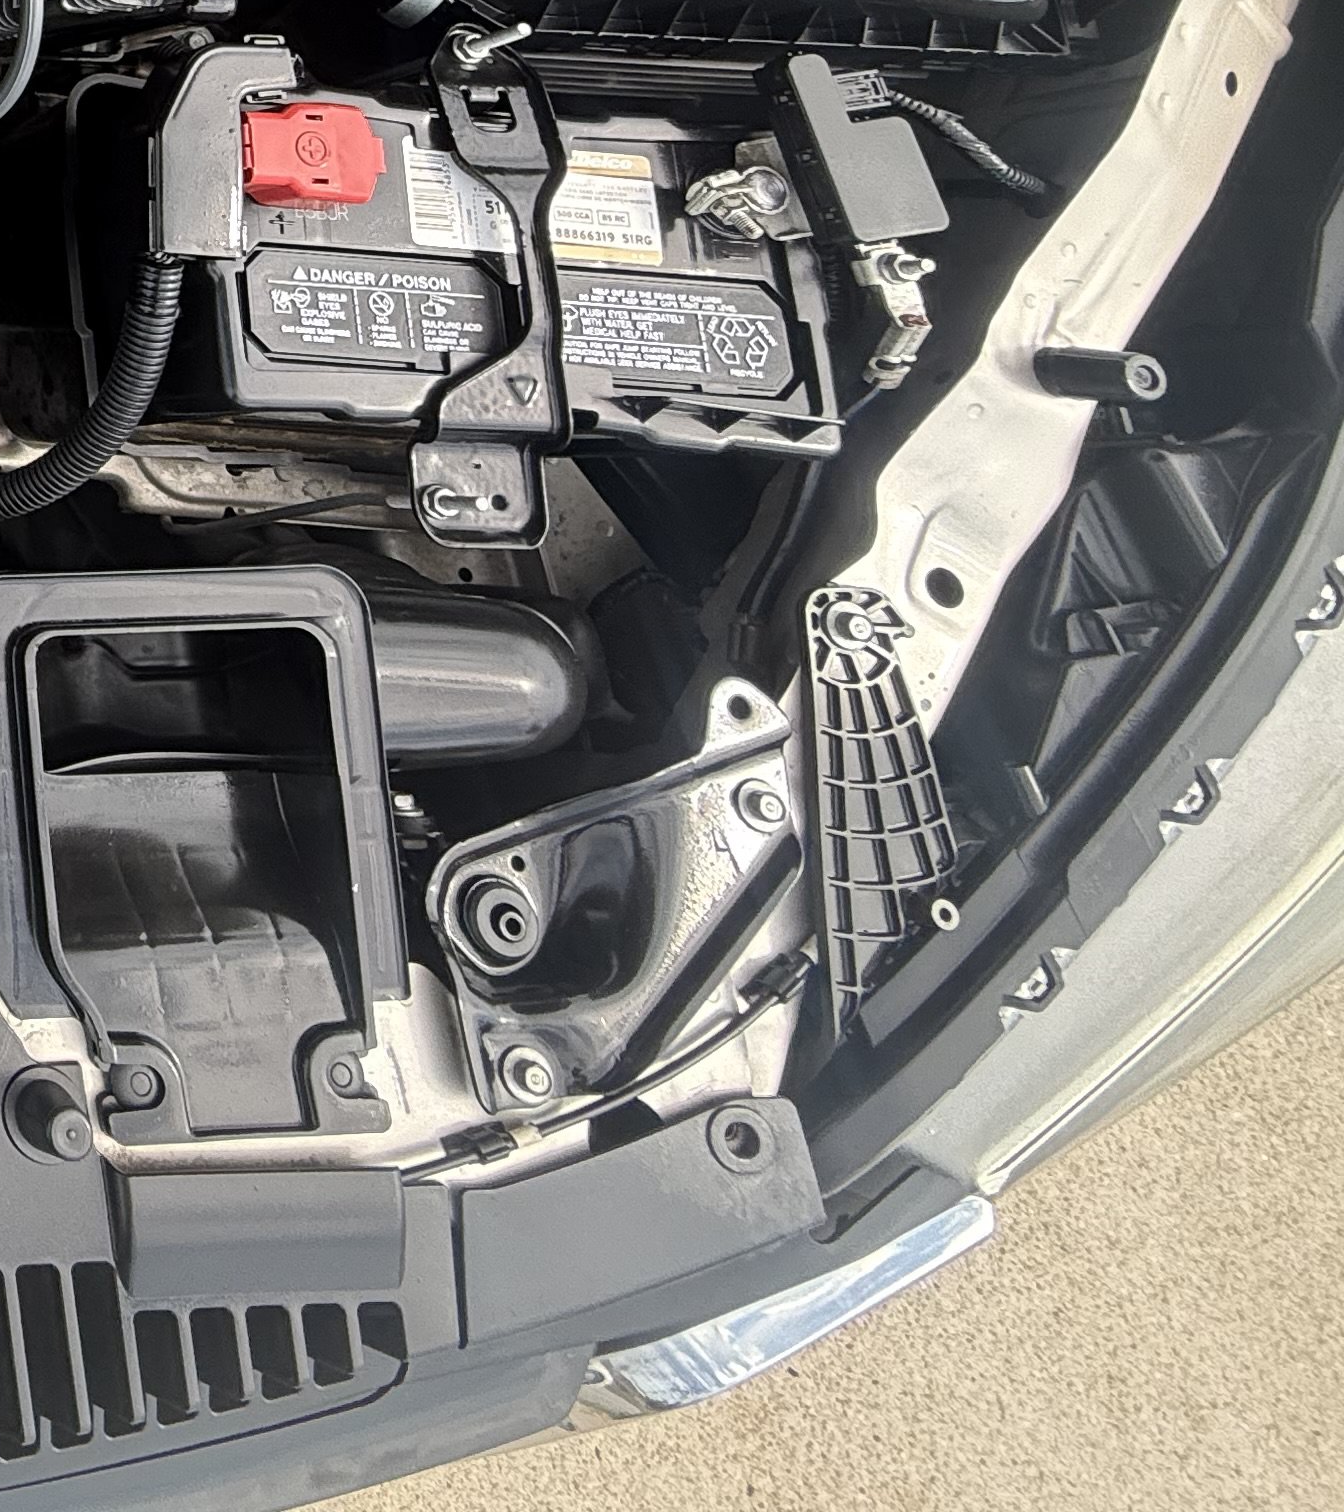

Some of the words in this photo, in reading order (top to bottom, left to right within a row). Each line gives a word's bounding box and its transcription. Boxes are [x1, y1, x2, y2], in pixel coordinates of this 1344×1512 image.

[574, 211, 590, 220] CCA
[614, 214, 625, 223] RC
[555, 228, 615, 242] 88866319
[622, 233, 653, 245] 51RG
[310, 268, 375, 286] DANGER
[392, 273, 451, 291] POISON
[608, 309, 629, 320] EYES
[581, 317, 603, 327] WITH
[636, 321, 653, 331] GET
[583, 326, 618, 338] MEDICAL
[620, 329, 641, 339] HELP
[643, 330, 664, 341] FAST
